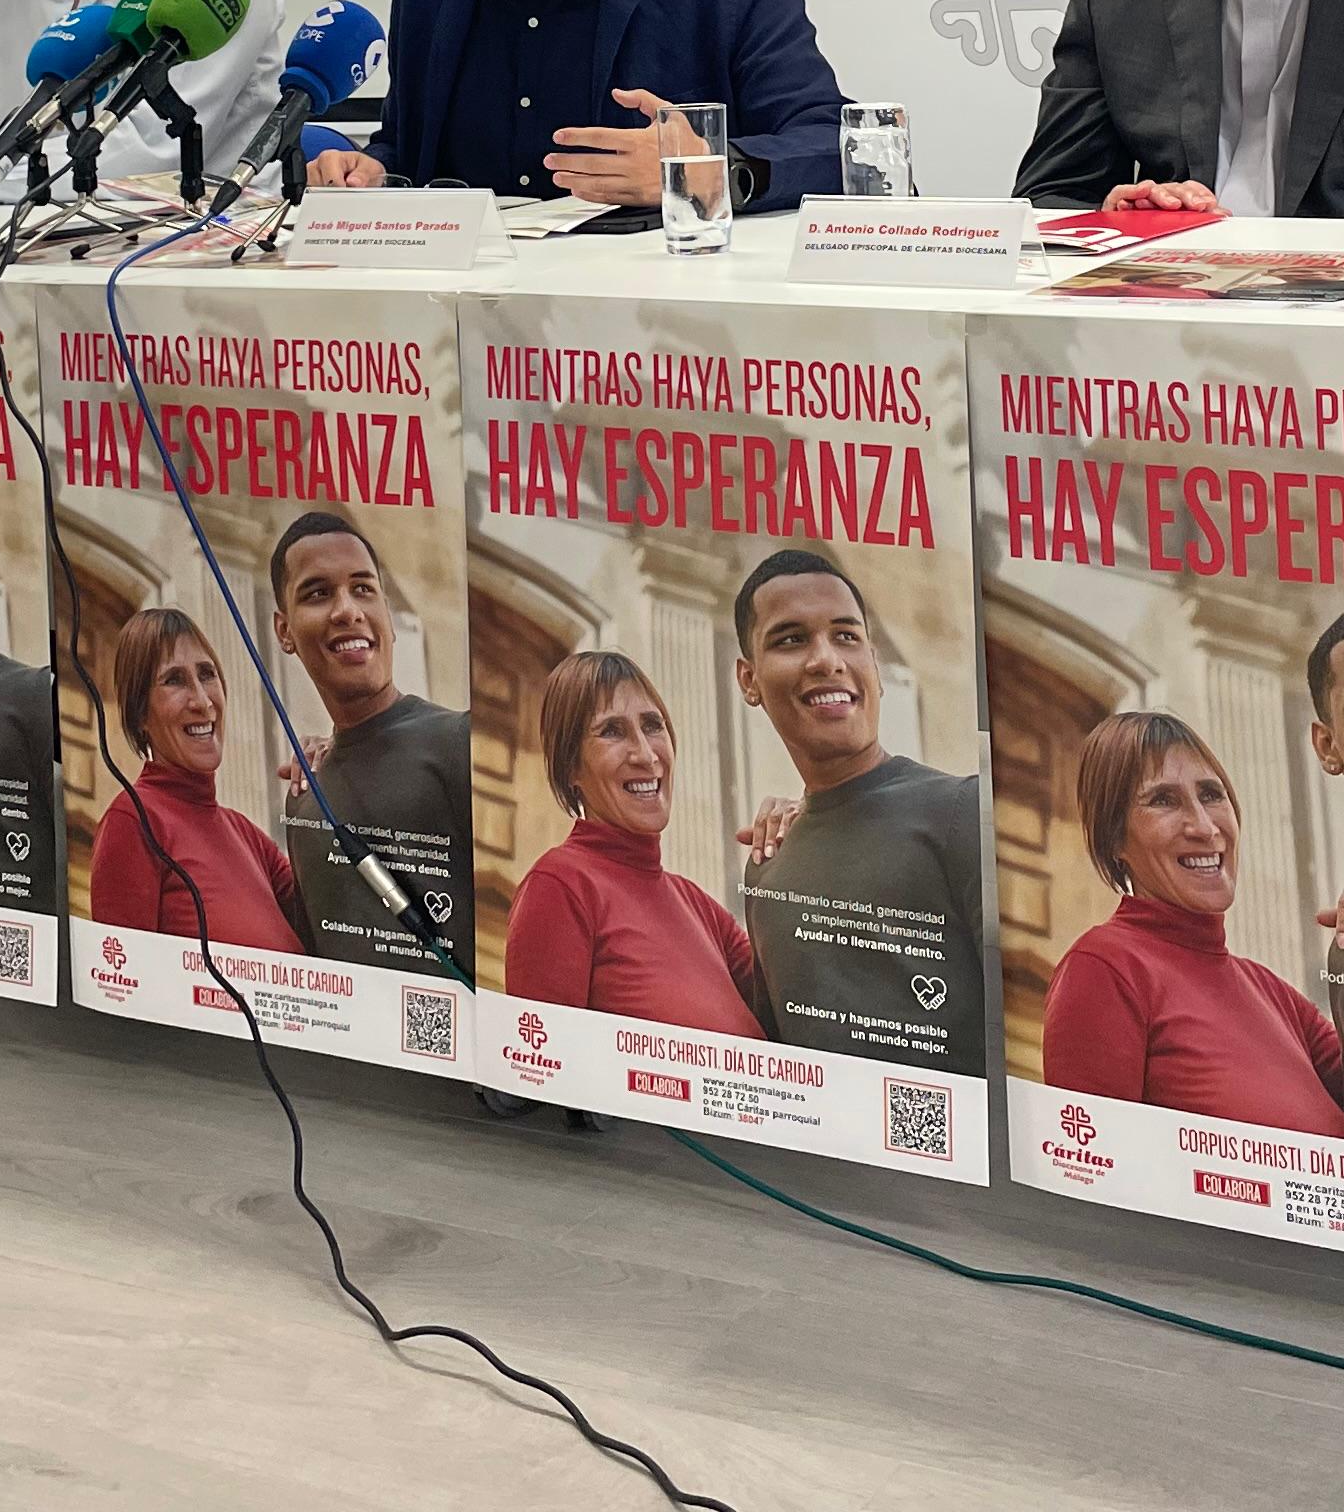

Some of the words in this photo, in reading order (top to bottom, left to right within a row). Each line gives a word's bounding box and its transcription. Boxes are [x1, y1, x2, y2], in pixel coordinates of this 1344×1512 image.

[295, 28, 325, 43] OPE
[308, 221, 333, 230] José
[336, 221, 373, 232] Miguel
[374, 221, 412, 231] Santos
[415, 222, 460, 231] Paradas
[808, 224, 821, 234] D.
[824, 224, 875, 234] Antonio
[879, 225, 928, 236] Collado
[851, 244, 899, 252] EPISCOPAL
[956, 246, 1008, 255] DIOCESANA
[60, 332, 190, 387] MIENTRAS
[198, 336, 265, 389] HAYA
[273, 339, 430, 401] PERSONAS,
[487, 345, 643, 409] MIENTRAS
[653, 353, 734, 413] HAYA
[743, 358, 932, 433] PERSONAS,
[1000, 373, 1192, 444] MIENTRAS
[1202, 382, 1304, 450] HAYA
[63, 399, 146, 489] HAY
[160, 403, 435, 508] ESPERANZA
[487, 418, 587, 520] HAY
[603, 426, 936, 550] ESPERANZA
[1004, 454, 1125, 568] HAY
[502, 1045, 563, 1071] Cáritas
[616, 1030, 665, 1060] CORPUS
[668, 1040, 721, 1070] CHRISTI.
[724, 1047, 745, 1074] DÍA
[749, 1054, 764, 1077] DE
[768, 1057, 824, 1087] CARIDAD
[635, 1073, 684, 1098] COLABORA
[1041, 1138, 1115, 1170] Cáritas
[1179, 1127, 1238, 1161] CORPUS
[1242, 1138, 1306, 1172] CHRISTI.
[1310, 1147, 1336, 1178] DÍA
[1203, 1175, 1262, 1203] COLABORA
